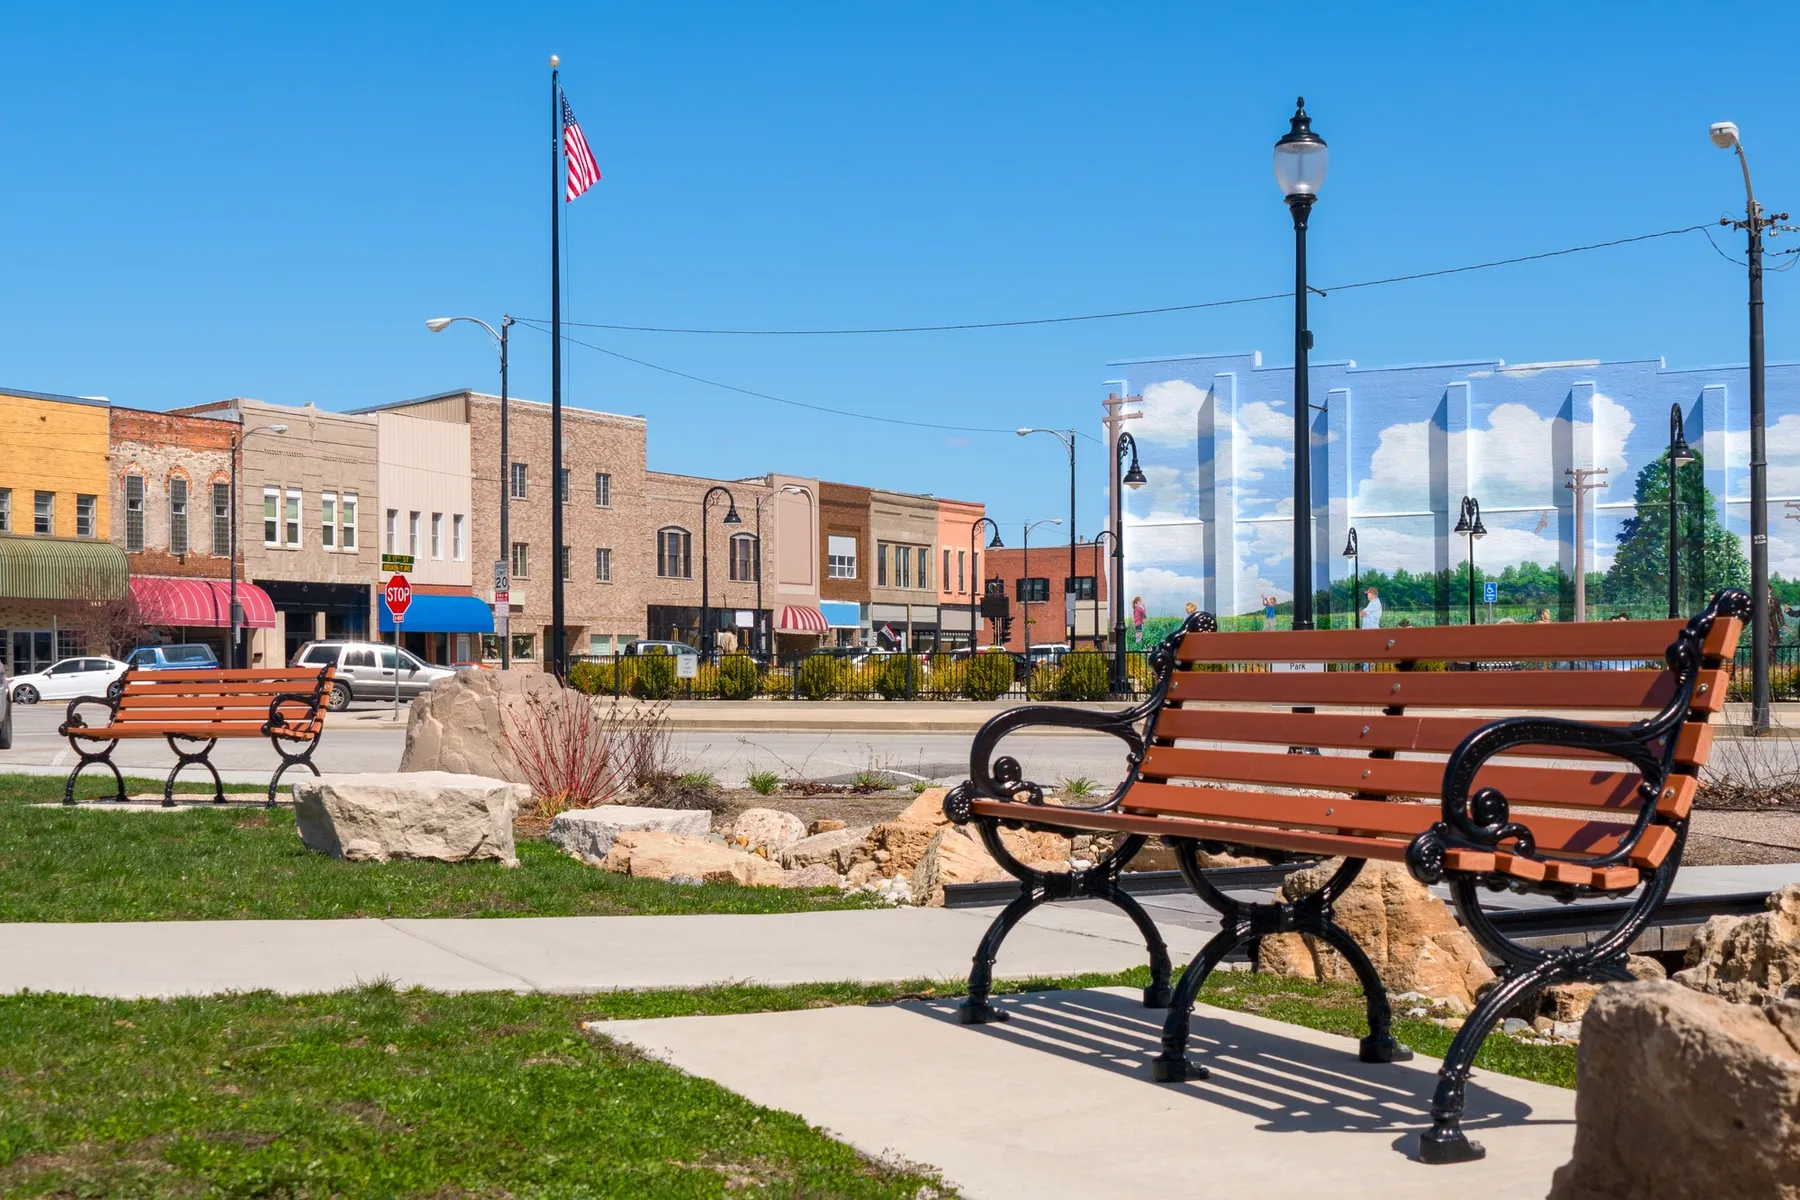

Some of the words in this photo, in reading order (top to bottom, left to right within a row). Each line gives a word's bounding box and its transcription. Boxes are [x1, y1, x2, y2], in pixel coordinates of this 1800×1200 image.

[496, 576, 507, 588] 20
[387, 587, 410, 602] STOP
[1289, 662, 1306, 671] Park
